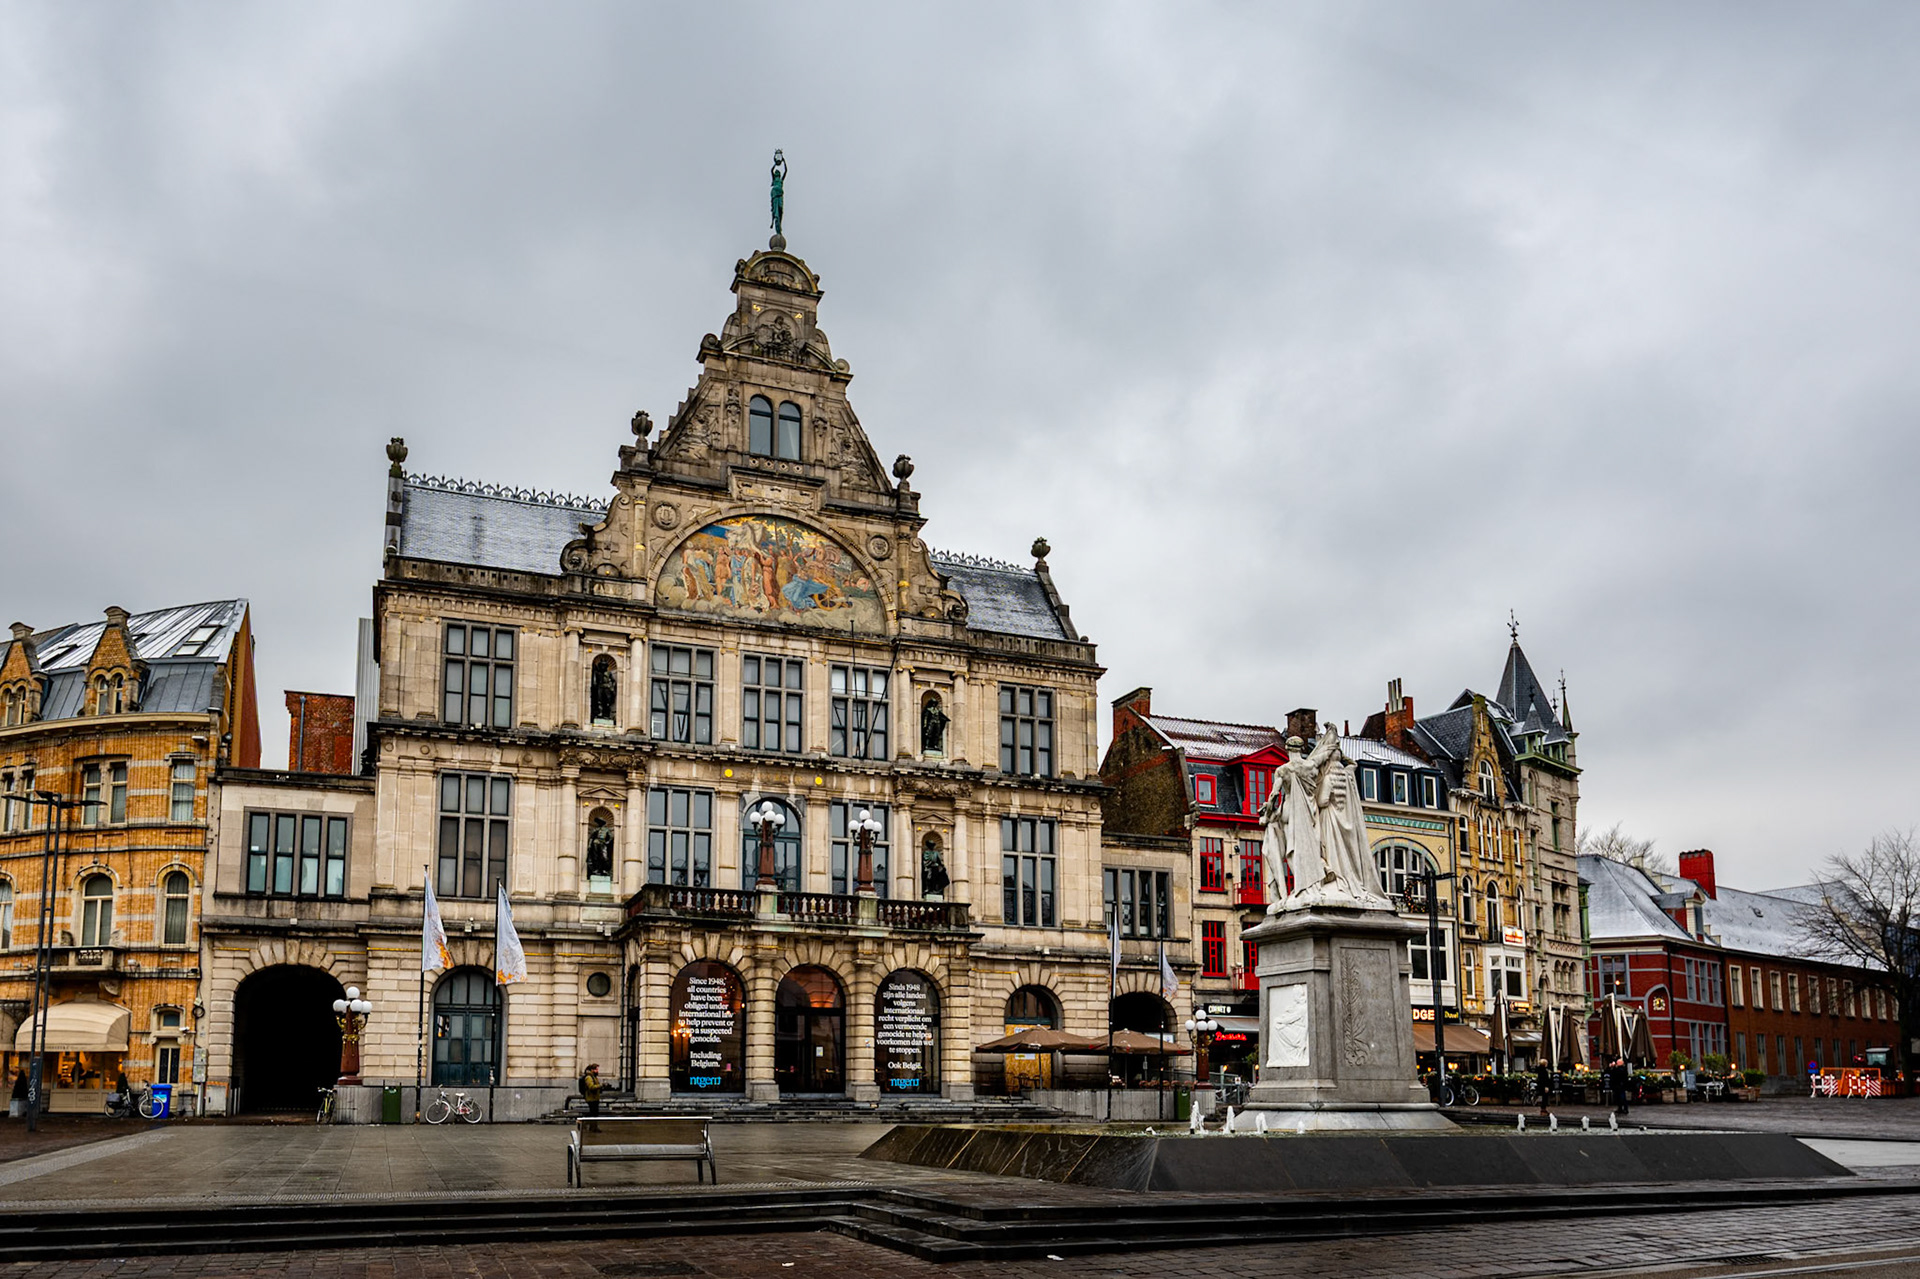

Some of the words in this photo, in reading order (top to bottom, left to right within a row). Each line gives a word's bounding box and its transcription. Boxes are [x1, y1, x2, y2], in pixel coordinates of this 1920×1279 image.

[708, 977, 726, 986] 1948,
[882, 991, 894, 1000] zijn
[684, 1001, 708, 1011] obliged
[892, 999, 916, 1008] volgens
[678, 1009, 720, 1018] international
[686, 1018, 700, 1027] help
[894, 1014, 920, 1024] verplicht
[700, 1026, 732, 1036] suspected
[878, 1030, 904, 1039] genocide
[690, 1034, 722, 1044] genocide.
[876, 1037, 910, 1046] voorkomen
[690, 1050, 722, 1061] Including
[690, 1059, 720, 1069] Belgium.
